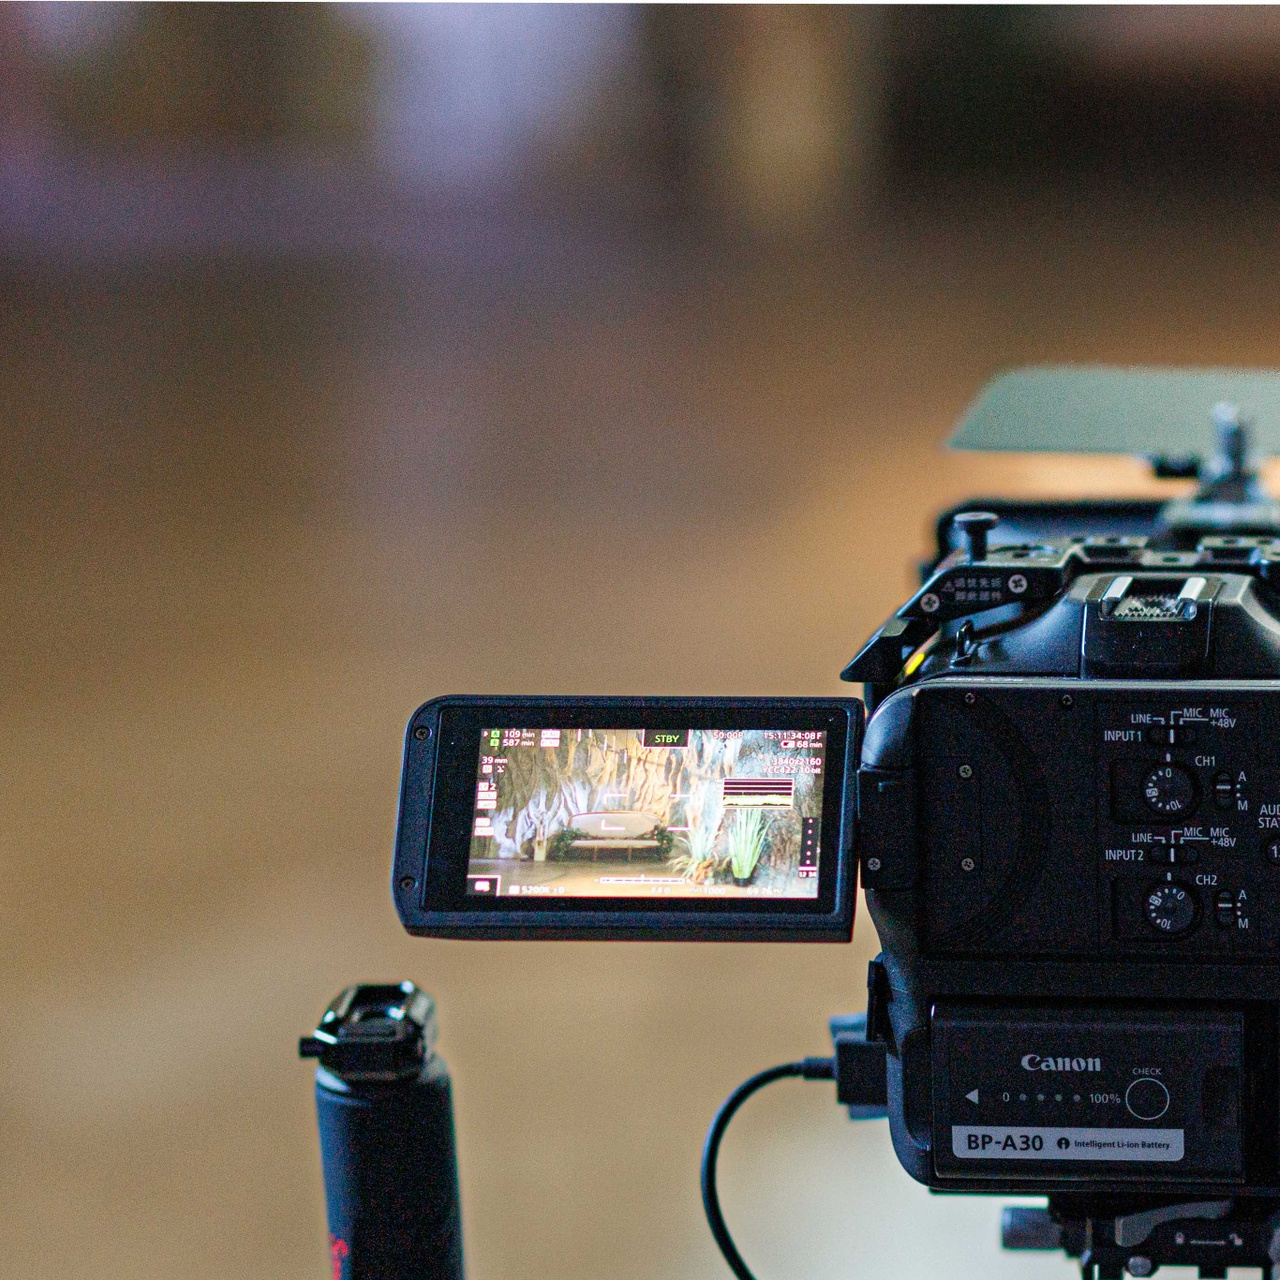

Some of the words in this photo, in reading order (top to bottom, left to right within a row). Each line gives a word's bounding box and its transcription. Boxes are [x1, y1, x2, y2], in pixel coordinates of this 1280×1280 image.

[1183, 707, 1203, 718] MIC
[1209, 708, 1229, 718] MIC
[1130, 714, 1152, 724] LINE
[1210, 718, 1237, 728] +48V
[504, 730, 521, 738] 109
[522, 730, 536, 738] min
[655, 734, 680, 743] STBY
[1104, 730, 1135, 742] INPUT
[1136, 731, 1142, 742] 1
[502, 739, 520, 747] 587
[521, 739, 535, 747] min
[482, 756, 493, 764] 39
[772, 757, 822, 765] 3840x2160
[1195, 756, 1216, 766] CH1
[763, 766, 797, 774] YCC422
[1165, 768, 1172, 778] 0
[1238, 771, 1247, 782] A
[1170, 799, 1182, 811] 10
[1237, 800, 1248, 811] M
[1183, 827, 1203, 837] MIC
[1210, 827, 1230, 838] MIC
[1132, 833, 1152, 843] LINE
[1211, 837, 1237, 847] +48V
[1105, 849, 1135, 861] INPUT
[1137, 850, 1144, 861] 2
[1195, 874, 1218, 886] CH2
[1176, 891, 1185, 900] 0
[1238, 889, 1247, 900] A
[1160, 918, 1172, 930] 10
[1238, 918, 1249, 929] M
[1021, 1054, 1101, 1072] Canon
[1132, 1067, 1162, 1076] CHECK
[1002, 1092, 1010, 1102] 0
[1089, 1093, 1121, 1104] 100%
[967, 1134, 1044, 1151] BP-A30
[1074, 1139, 1115, 1150] Intelligent
[1117, 1140, 1140, 1149] Li-ion
[1141, 1141, 1170, 1150] Battery
